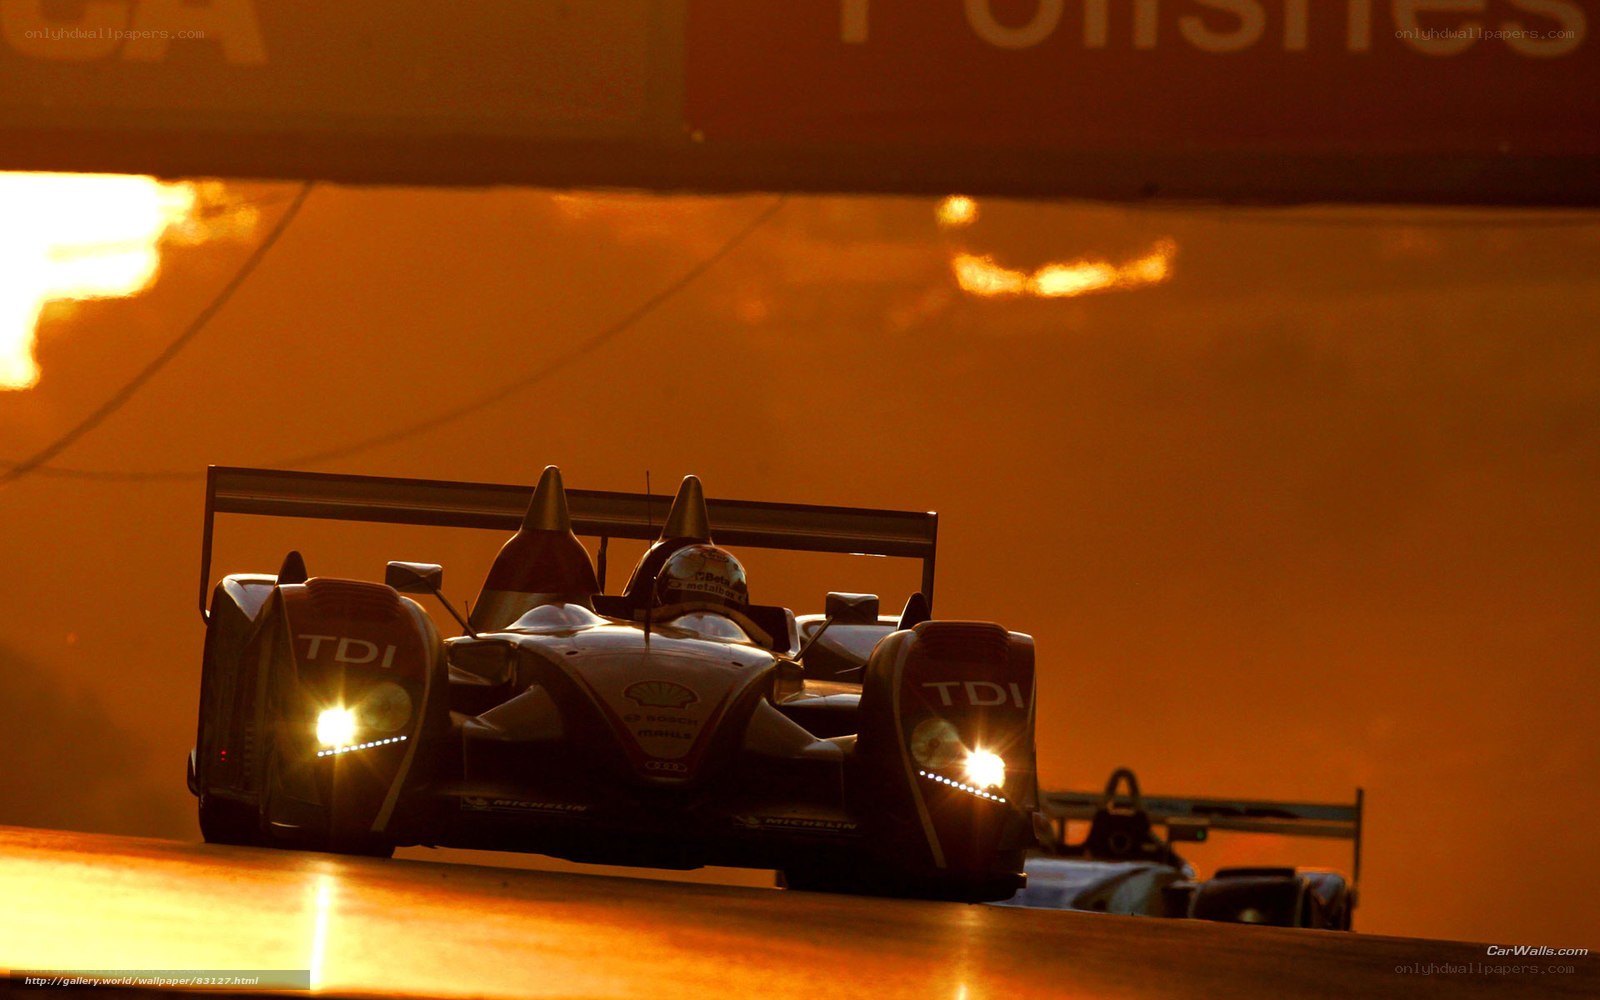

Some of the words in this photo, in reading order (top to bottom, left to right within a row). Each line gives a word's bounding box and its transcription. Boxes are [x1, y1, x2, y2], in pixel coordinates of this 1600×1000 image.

[298, 634, 397, 668] TDI
[921, 680, 1025, 708] TDI
[493, 800, 587, 812] MICHELIN
[765, 818, 858, 830] MICHELIN
